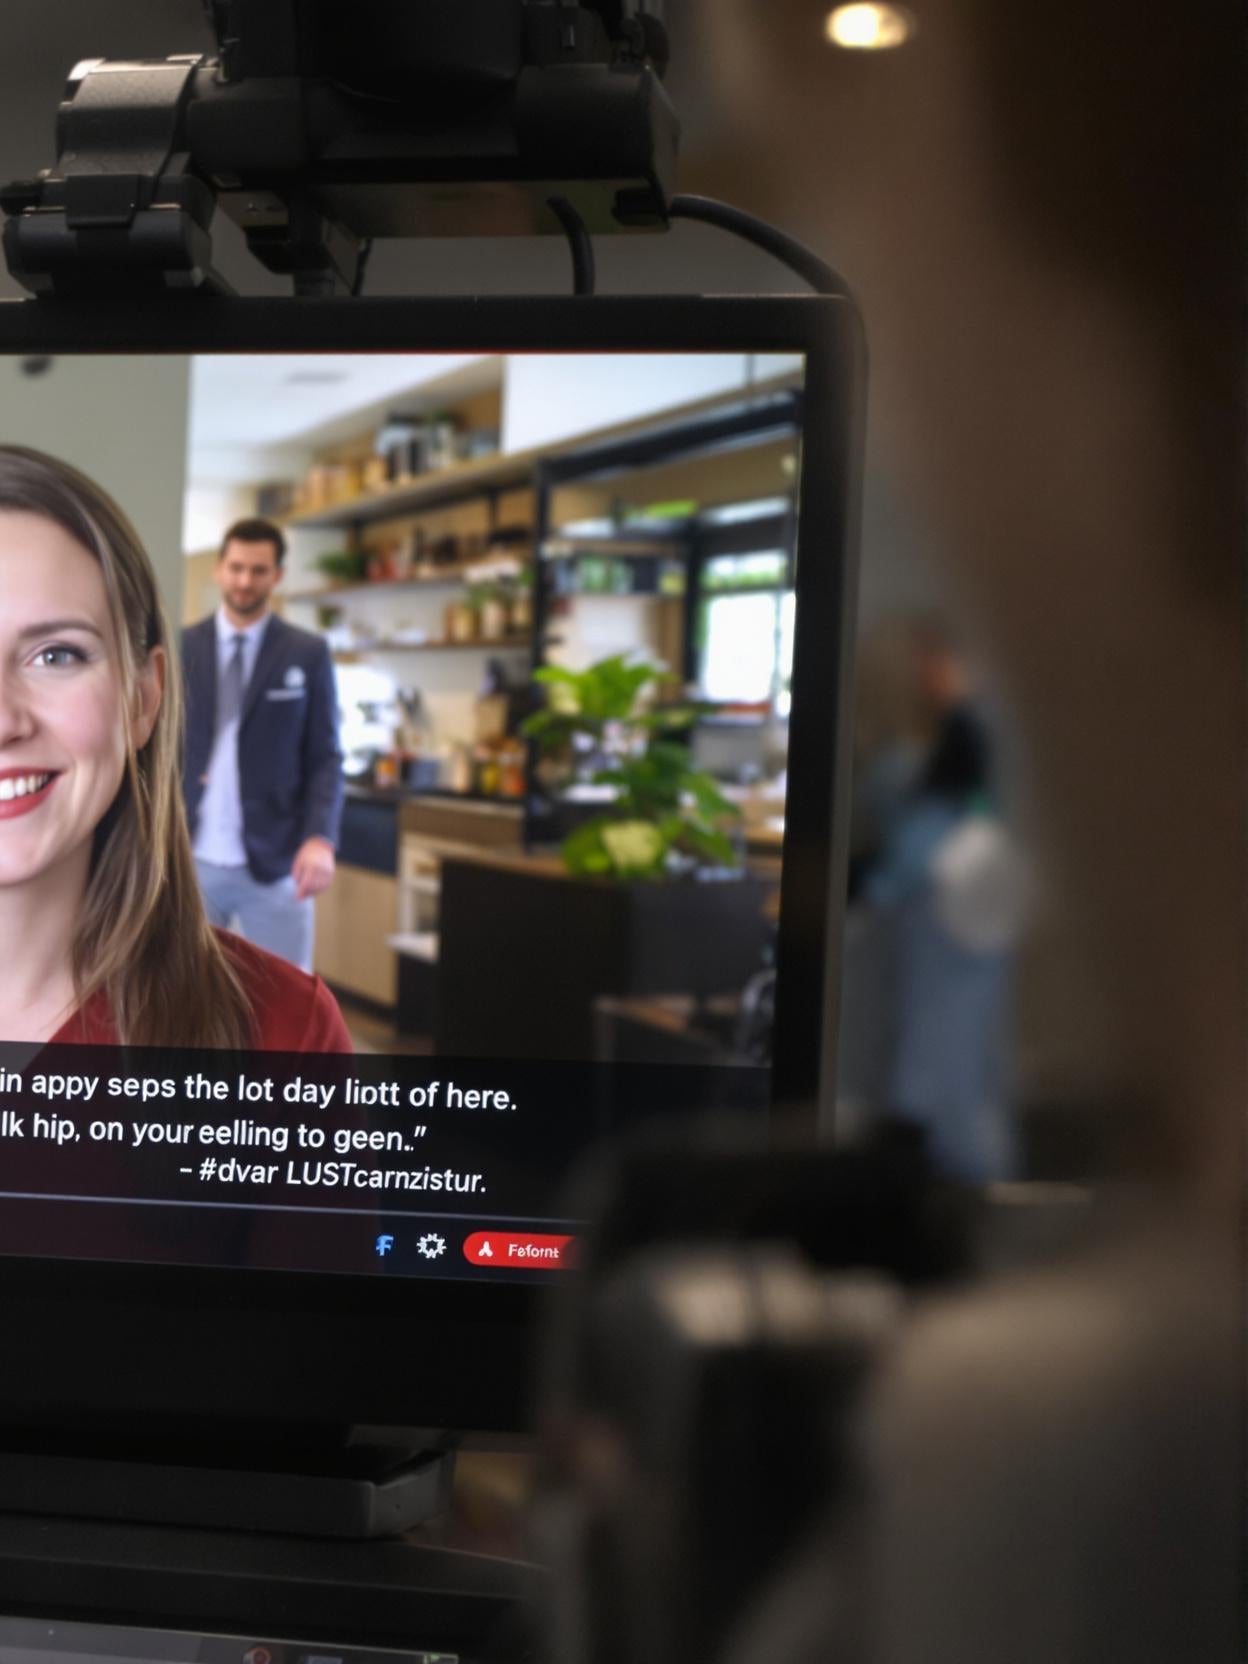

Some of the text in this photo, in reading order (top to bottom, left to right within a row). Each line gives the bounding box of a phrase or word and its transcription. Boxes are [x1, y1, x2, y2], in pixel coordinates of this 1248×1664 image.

[31, 1074, 100, 1101] appy
[107, 1077, 176, 1103] seps
[184, 1072, 230, 1100] the
[238, 1074, 274, 1102] lot
[283, 1076, 336, 1110] day
[409, 1081, 440, 1108] of
[446, 1081, 517, 1111] here.
[33, 1112, 81, 1146] hip,
[89, 1120, 124, 1141] on
[132, 1122, 195, 1147] your
[198, 1119, 289, 1152] eelling
[297, 1123, 326, 1148] to
[199, 1157, 279, 1184] #dvar
